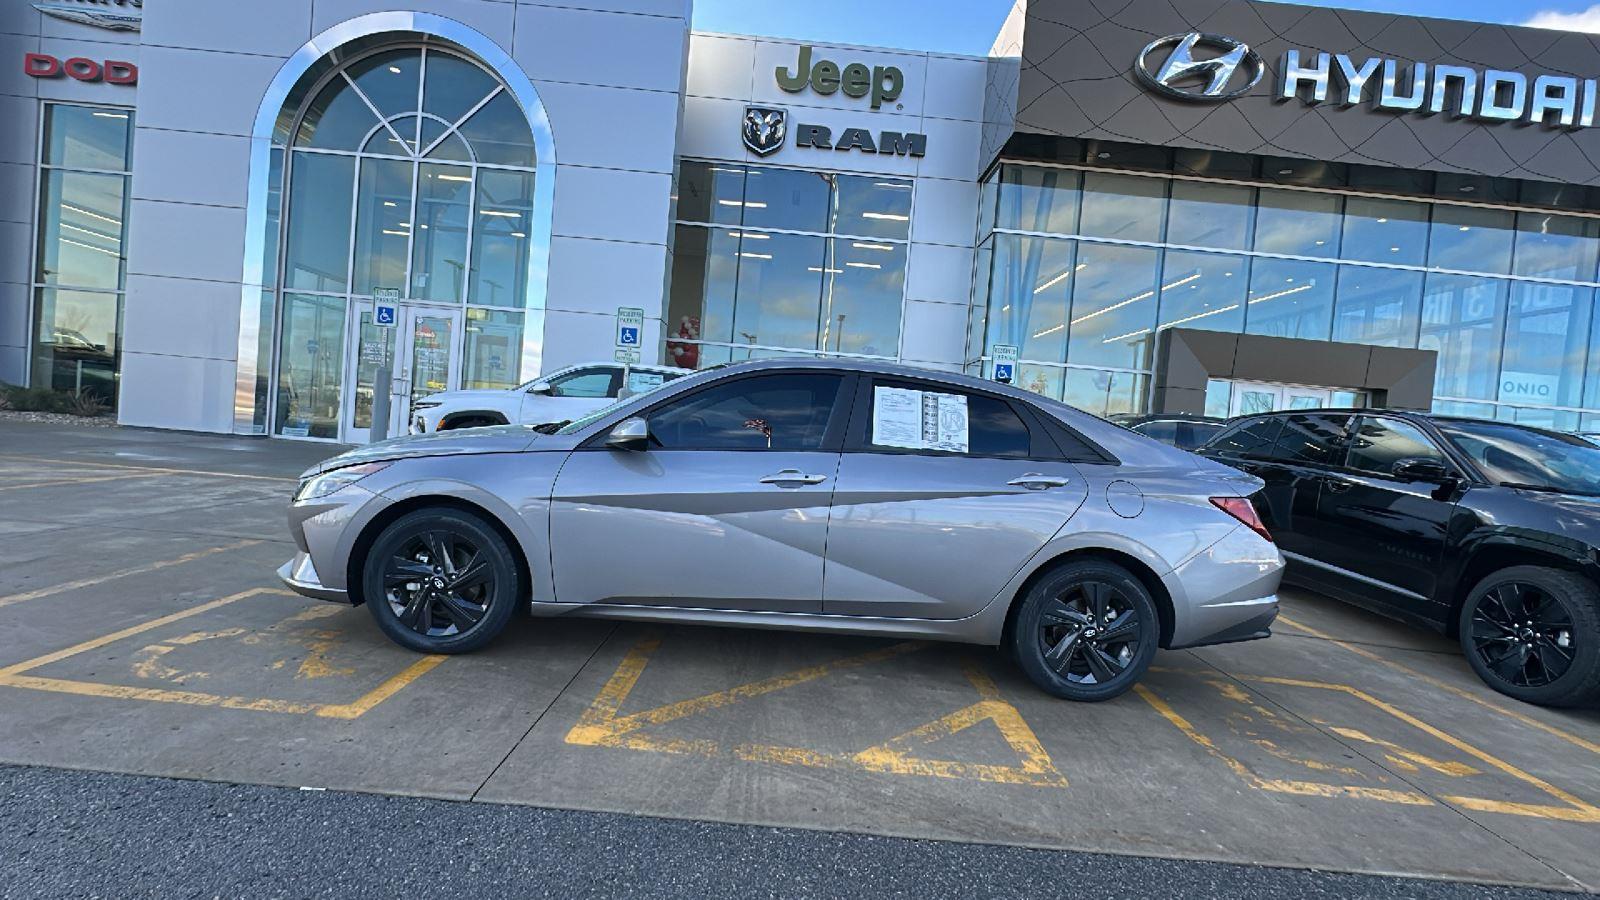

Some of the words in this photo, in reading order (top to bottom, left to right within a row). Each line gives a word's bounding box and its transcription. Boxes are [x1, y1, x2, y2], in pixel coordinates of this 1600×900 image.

[25, 53, 138, 85] DOD
[775, 46, 904, 109] Jeep
[1278, 49, 1598, 128] HYUNDAI
[797, 123, 927, 157] RAM
